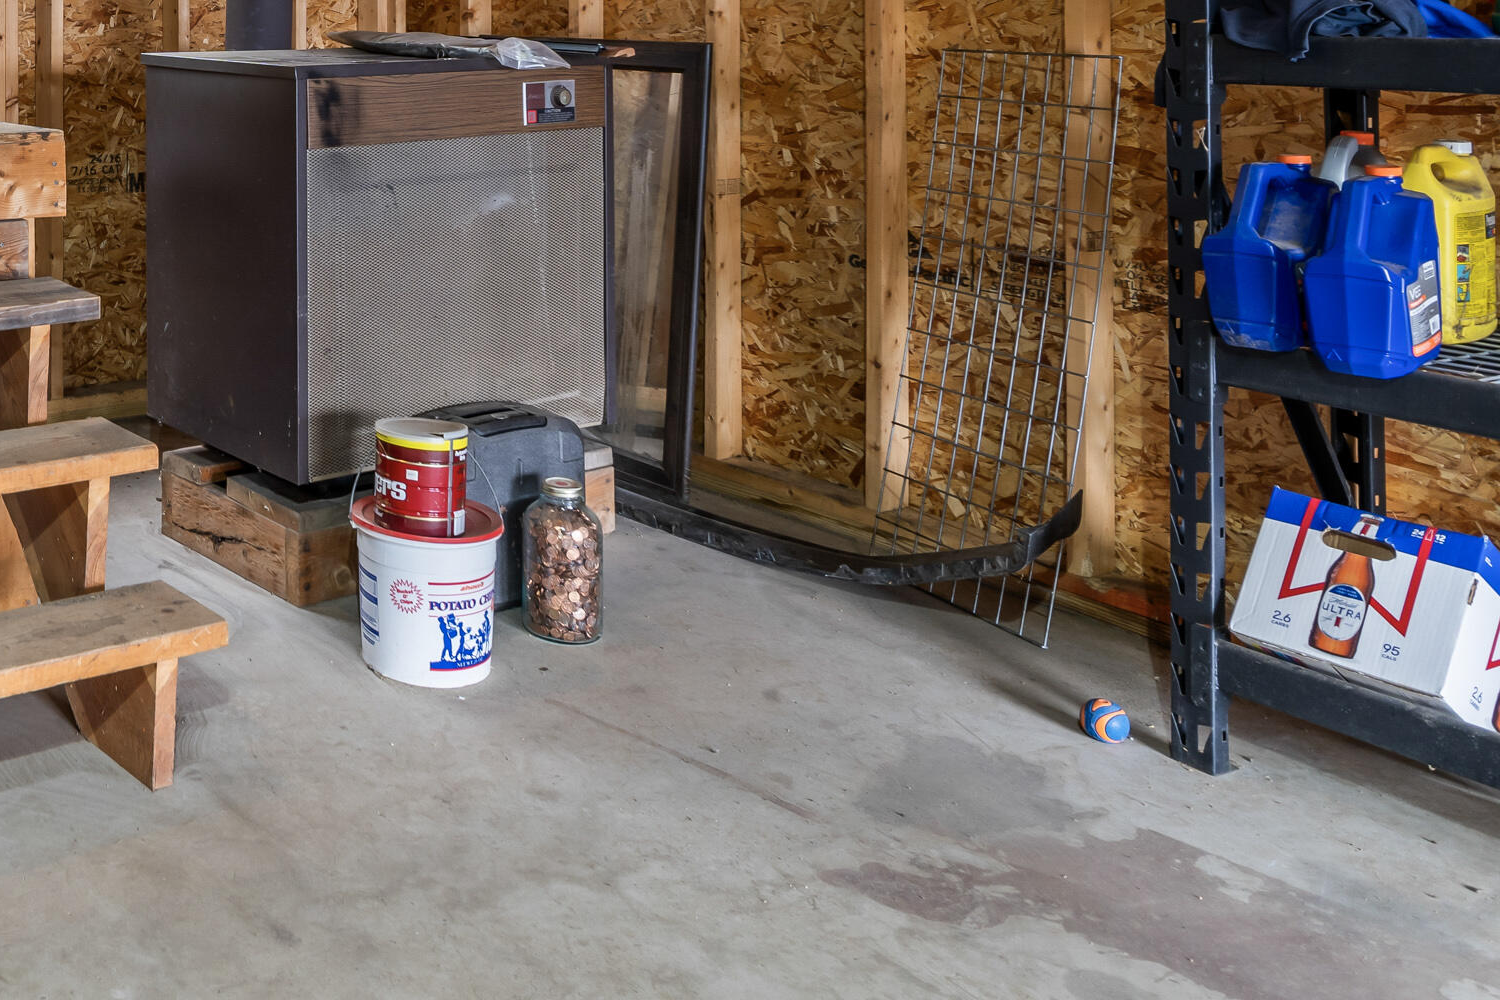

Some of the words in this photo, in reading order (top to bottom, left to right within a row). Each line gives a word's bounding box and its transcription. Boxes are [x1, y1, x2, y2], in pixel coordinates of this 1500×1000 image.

[428, 598, 476, 611] POTATO
[1322, 601, 1361, 620] ULTRA
[1272, 610, 1291, 623] 2.6
[1383, 643, 1401, 656] 95
